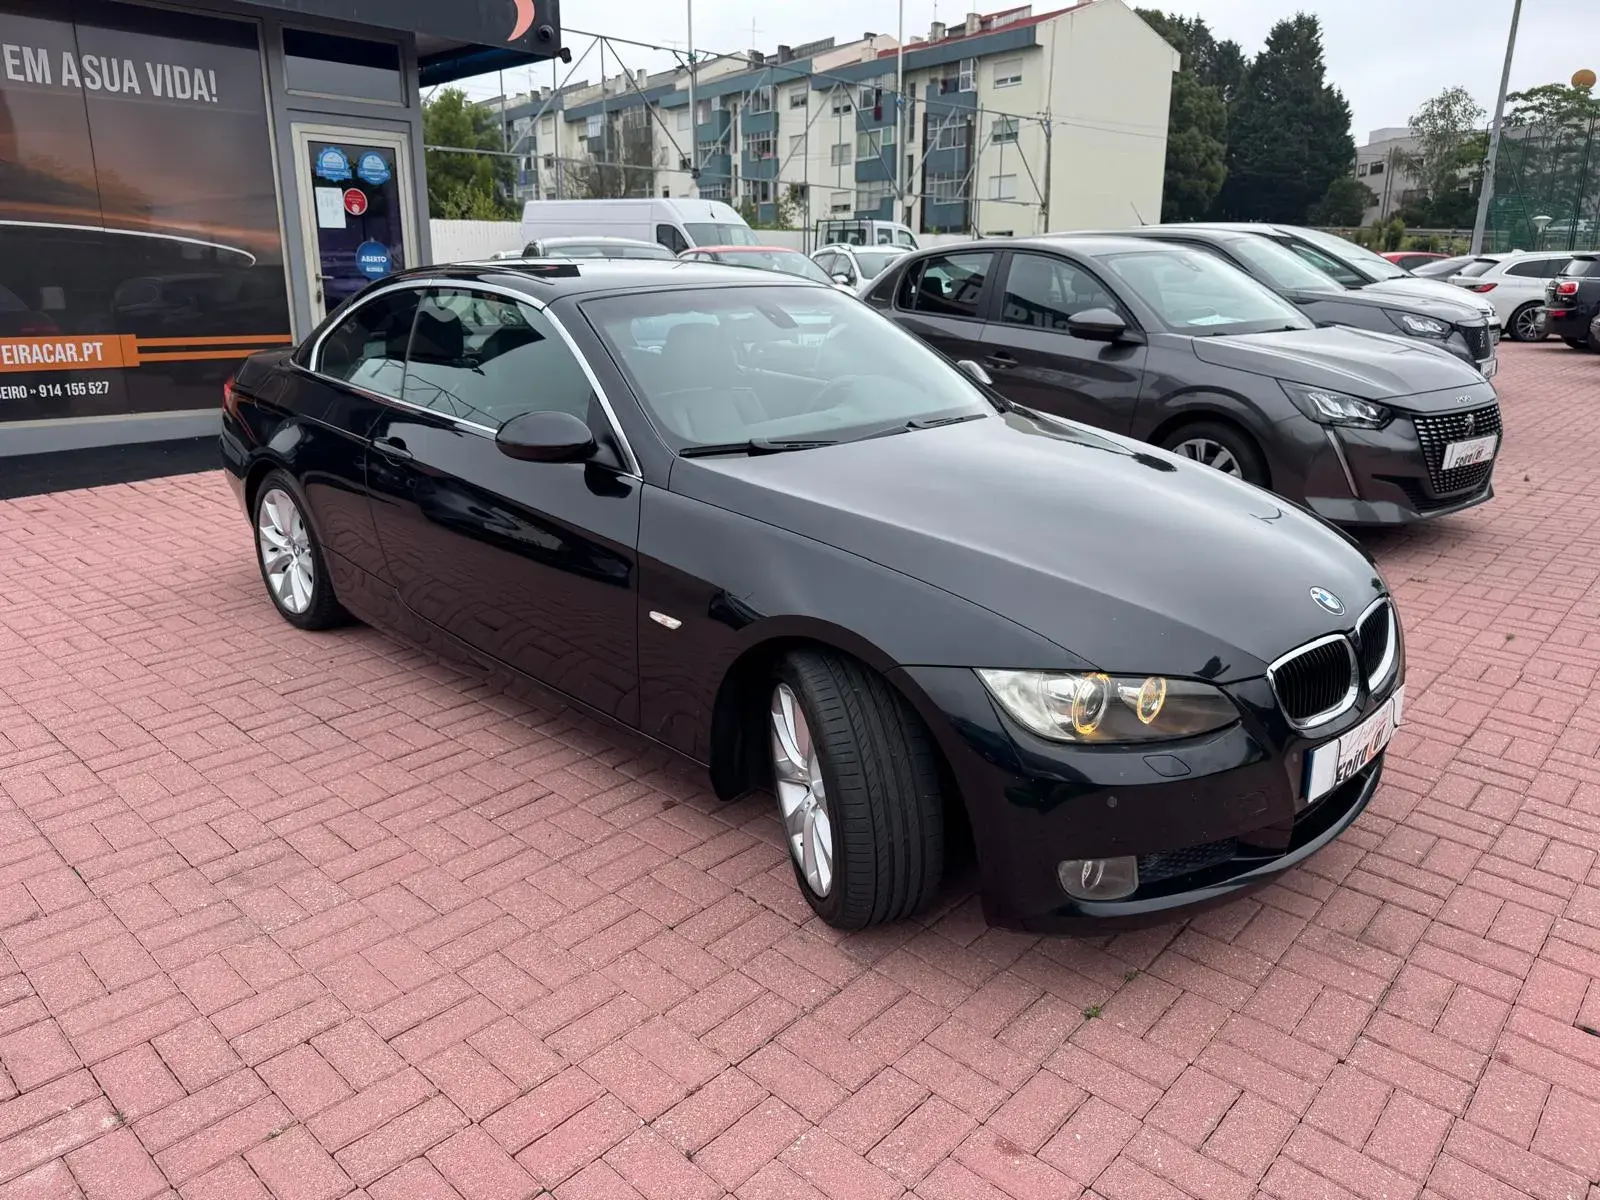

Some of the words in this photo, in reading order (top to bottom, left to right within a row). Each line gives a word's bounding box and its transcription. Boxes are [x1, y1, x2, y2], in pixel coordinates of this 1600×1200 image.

[2, 43, 52, 85] EM
[145, 61, 218, 103] VIDA!
[361, 255, 387, 263] ABERTO
[1, 342, 103, 365] EIRACAR.PT
[39, 383, 62, 398] 914
[65, 382, 87, 396] 155
[88, 381, 109, 395] 527
